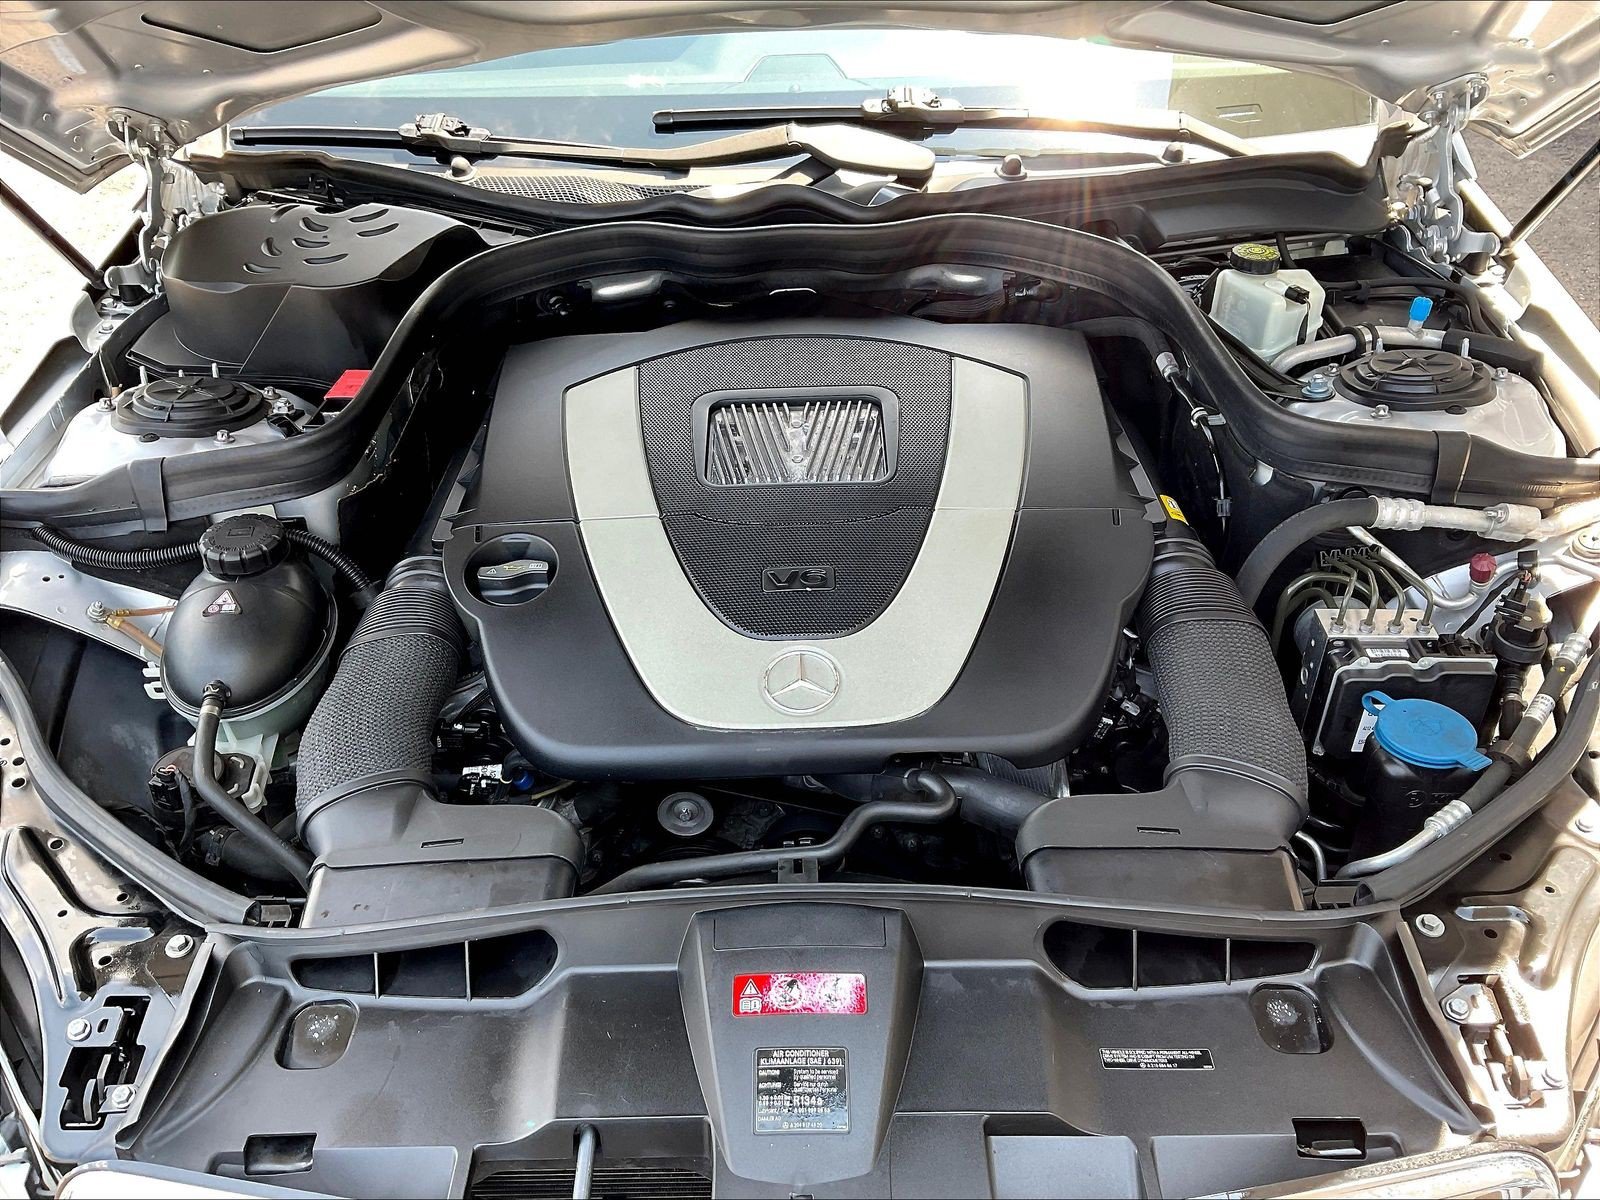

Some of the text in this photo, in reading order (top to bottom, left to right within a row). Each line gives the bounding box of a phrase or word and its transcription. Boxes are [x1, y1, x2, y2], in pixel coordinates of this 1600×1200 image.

[766, 568, 827, 586] V6
[773, 1050, 829, 1058] AIR CONDITIONER
[760, 1058, 807, 1066] KLIMAANLAGE
[807, 1058, 822, 1066] (SAE
[827, 1058, 842, 1066] 639)
[793, 1095, 823, 1106] R134a
